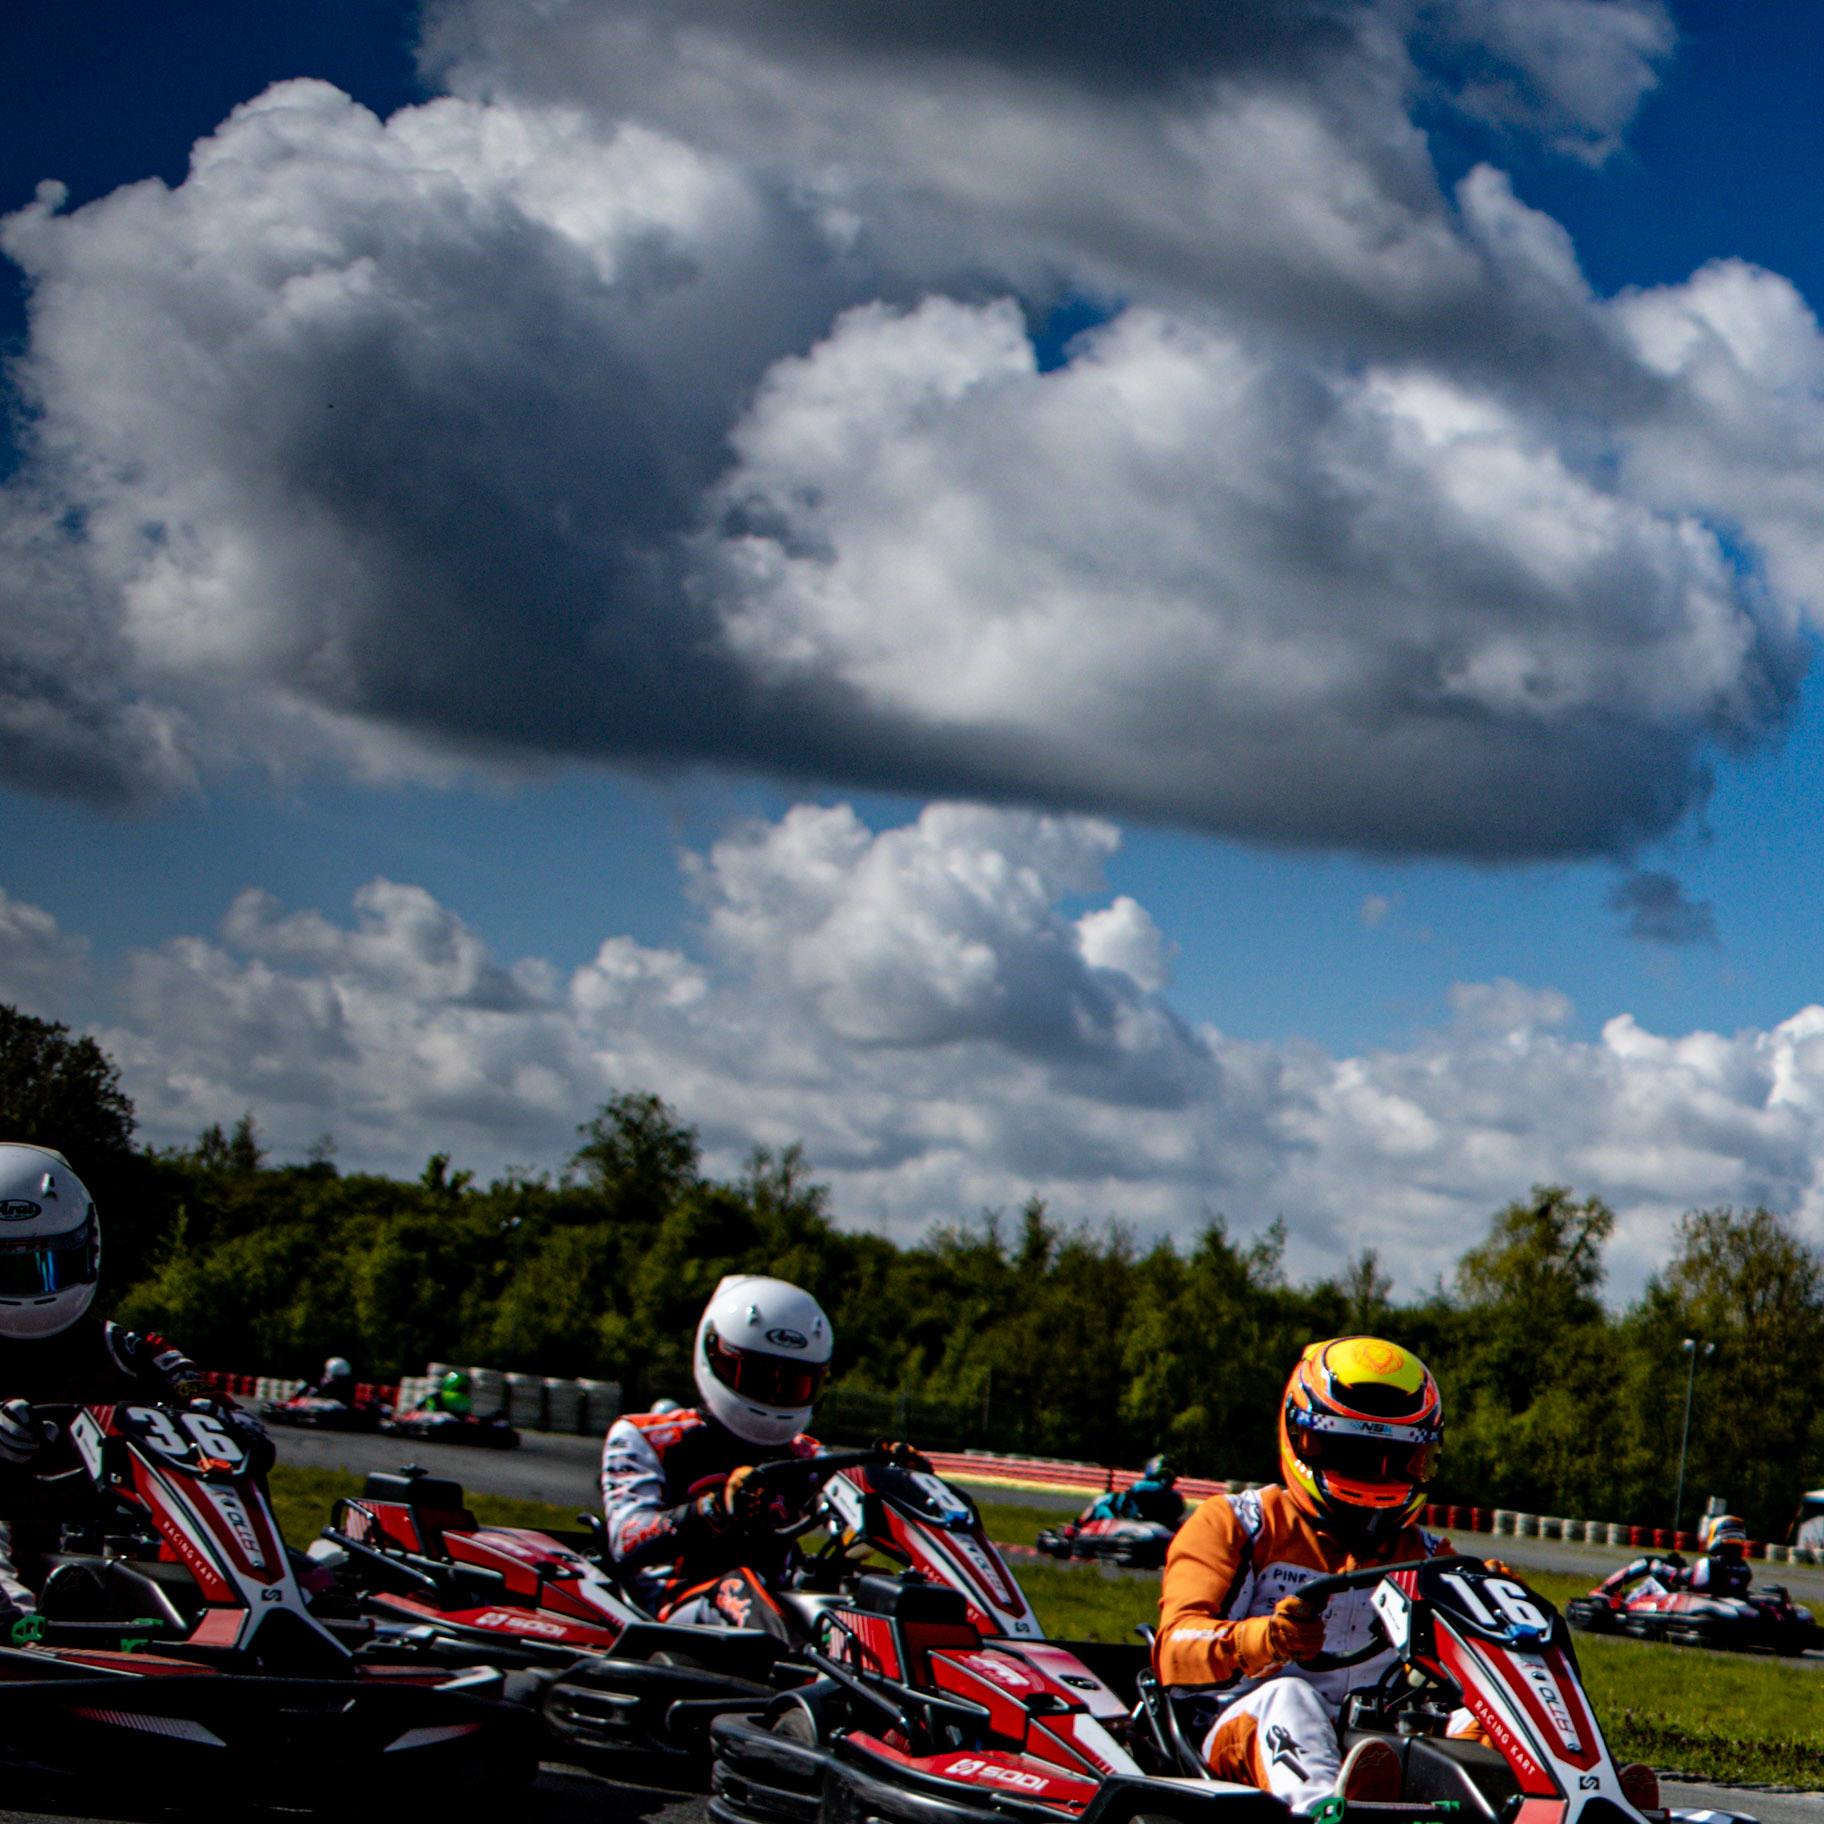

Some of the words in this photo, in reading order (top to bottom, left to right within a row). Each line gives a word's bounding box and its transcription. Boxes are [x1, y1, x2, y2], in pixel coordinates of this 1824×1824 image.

[126, 1406, 244, 1461] 36
[163, 1520, 194, 1559] RACING
[1438, 1573, 1550, 1629] 16
[1474, 1699, 1510, 1745] RACING
[1510, 1744, 1536, 1776] KART
